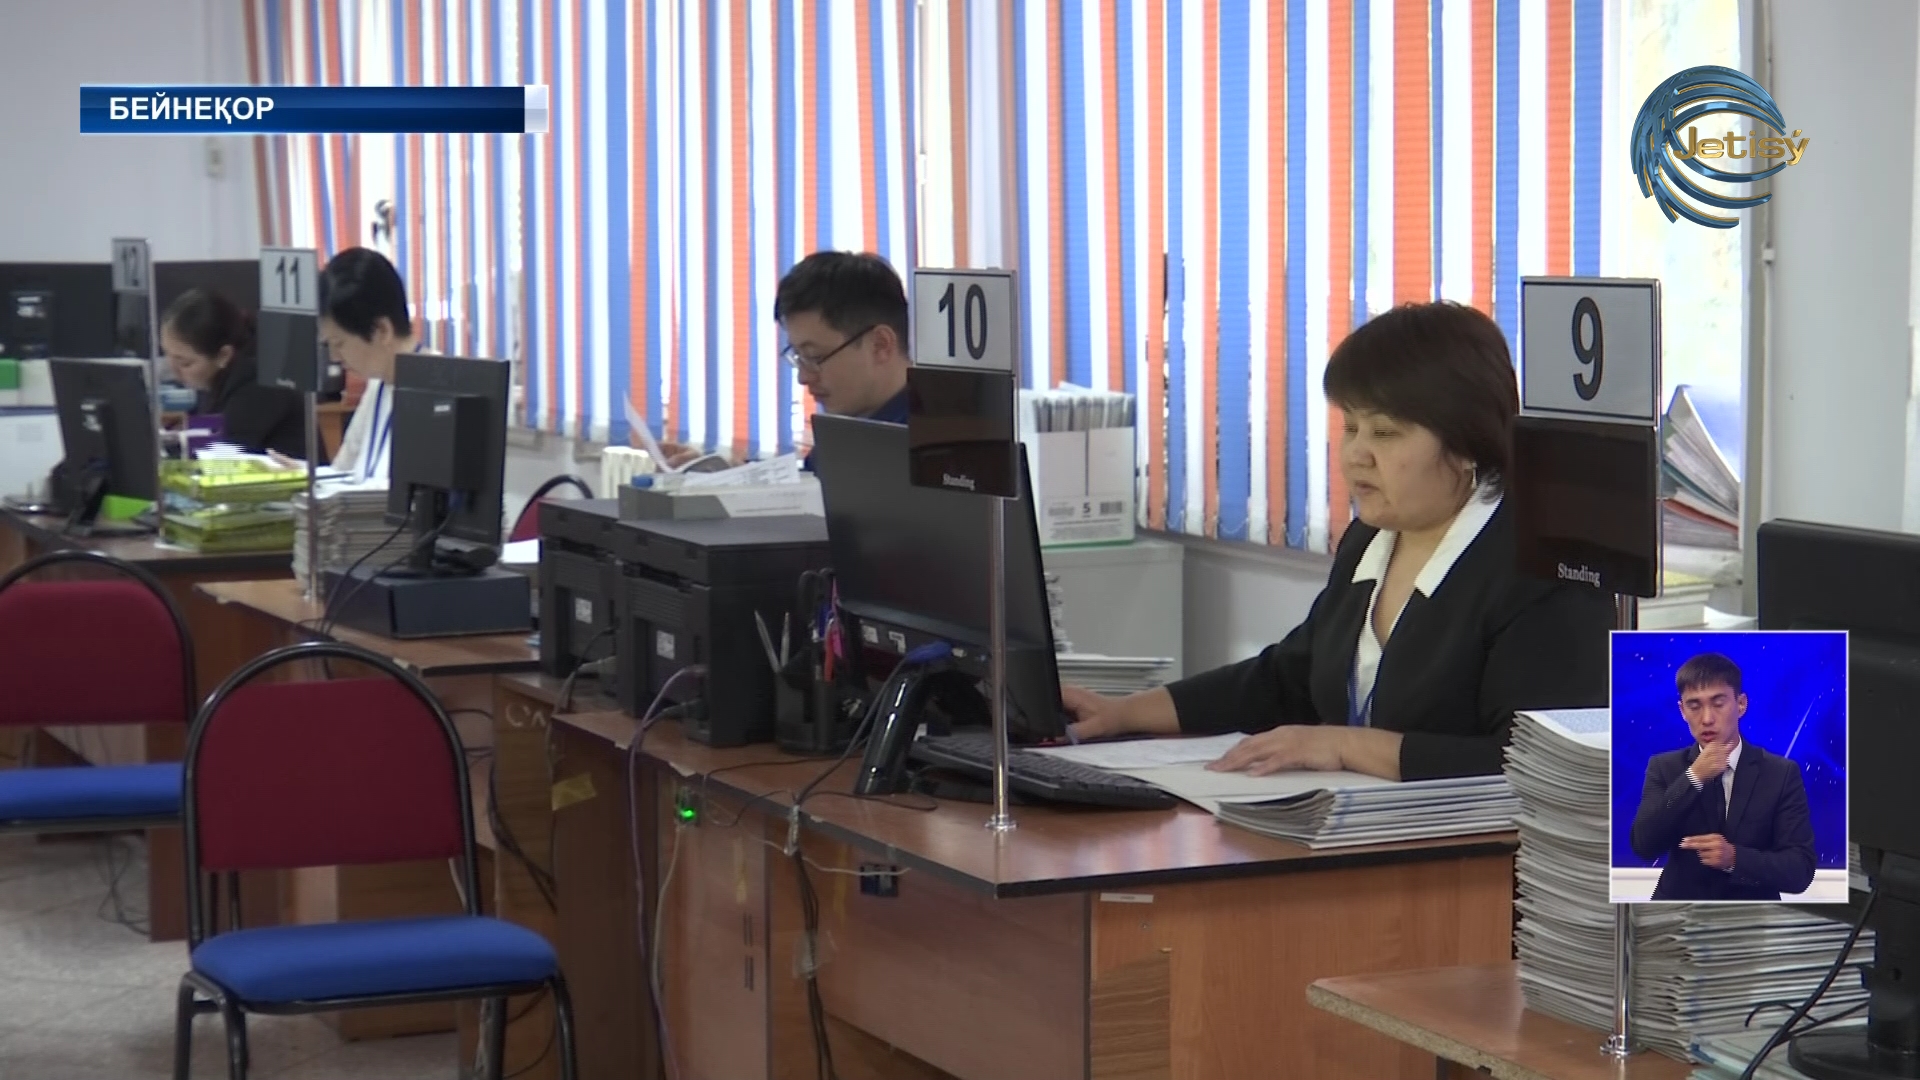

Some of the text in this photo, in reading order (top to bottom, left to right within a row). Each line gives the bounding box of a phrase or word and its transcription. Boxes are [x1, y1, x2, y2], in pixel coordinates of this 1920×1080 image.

[276, 256, 300, 304] 11
[938, 282, 988, 360] 10
[1571, 296, 1604, 401] 9
[1557, 562, 1601, 588] Standing
